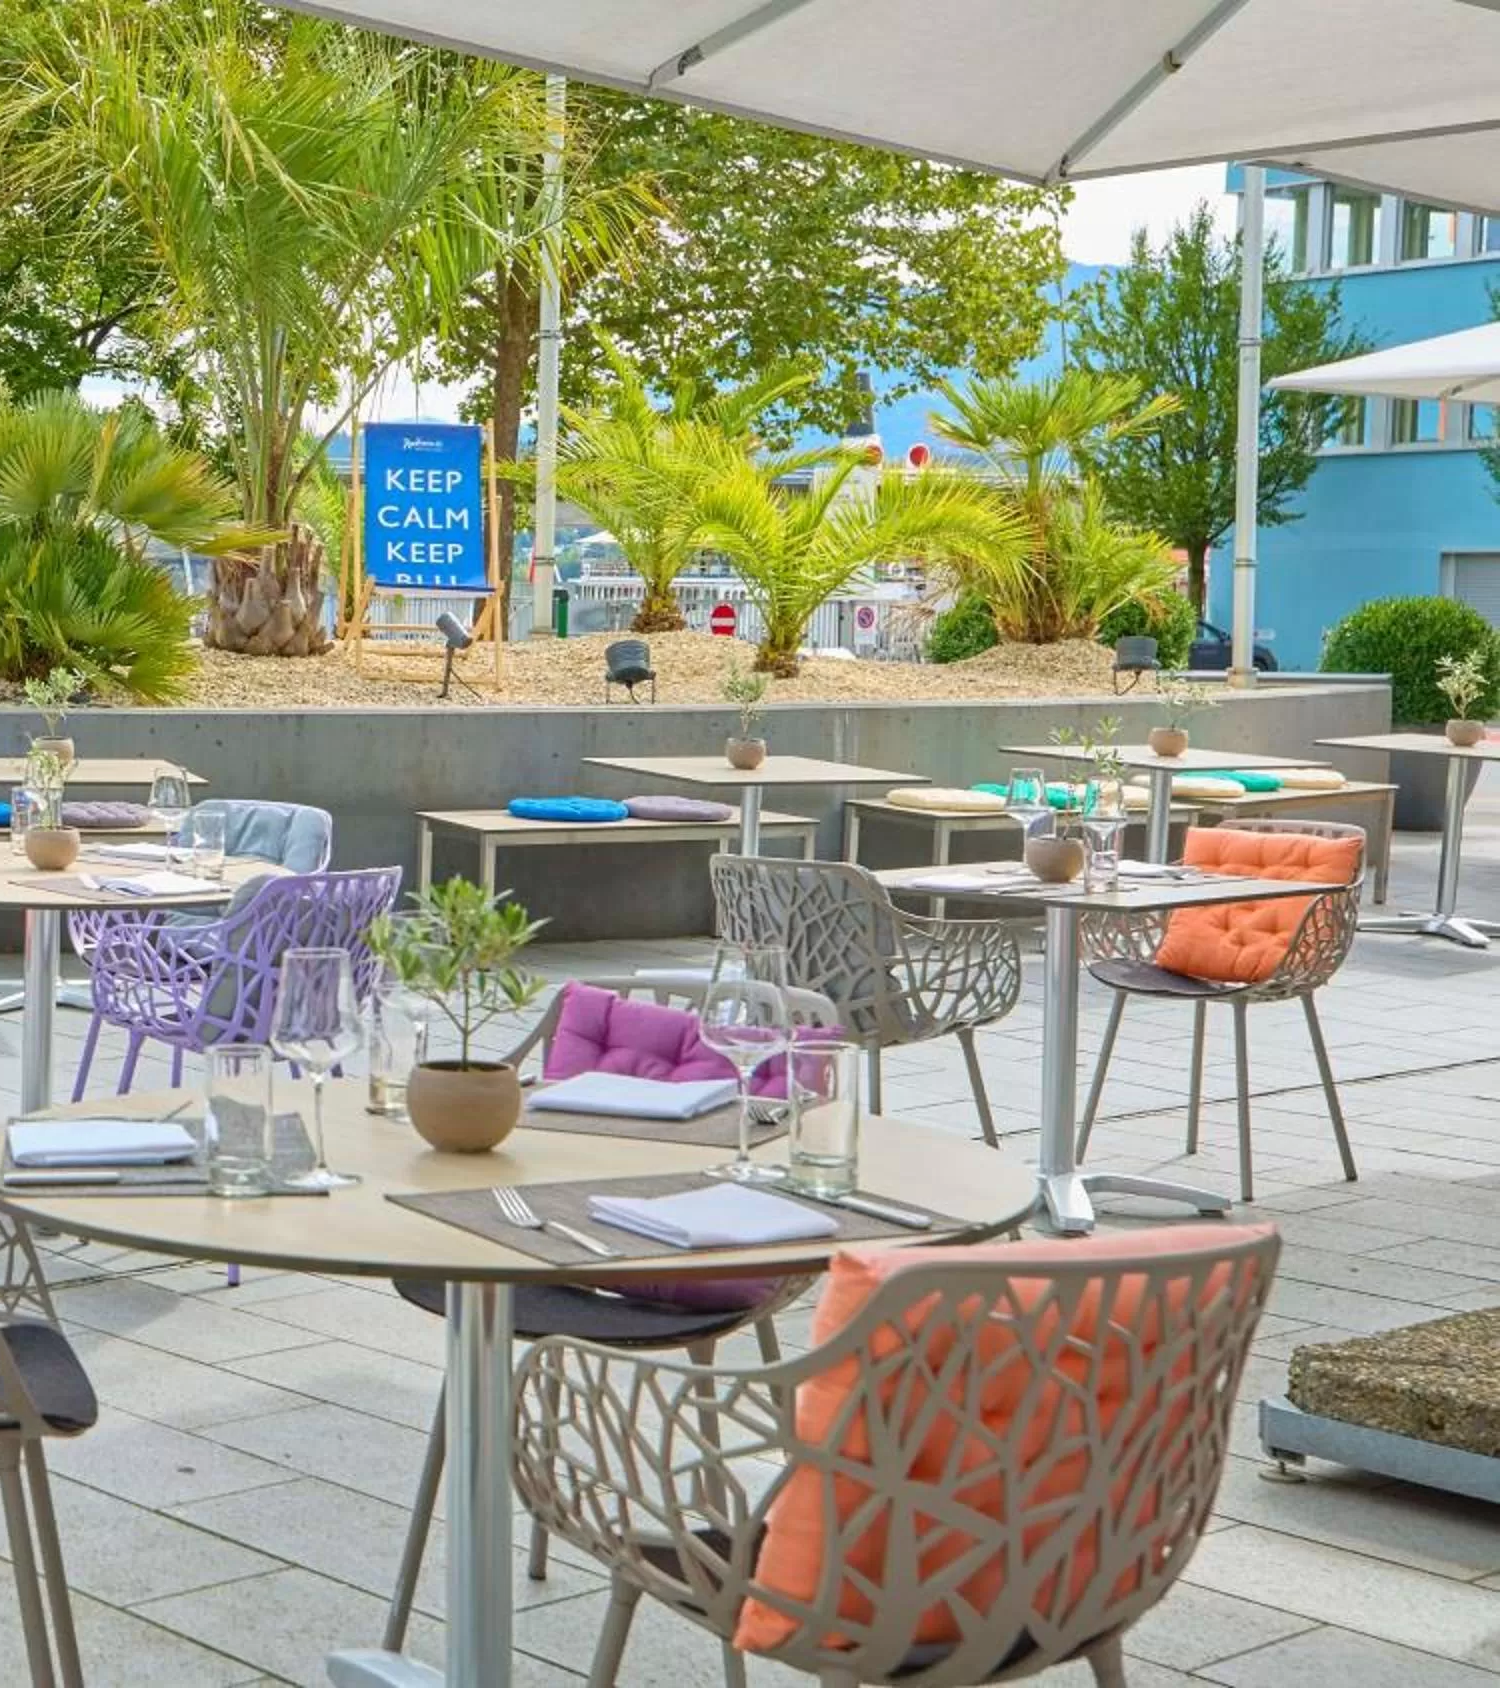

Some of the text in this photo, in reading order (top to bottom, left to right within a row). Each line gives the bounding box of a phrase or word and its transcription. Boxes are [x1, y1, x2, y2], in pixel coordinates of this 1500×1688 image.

[386, 469, 462, 493] KEEP
[377, 505, 469, 530] CALM
[387, 541, 464, 564] KEEP
